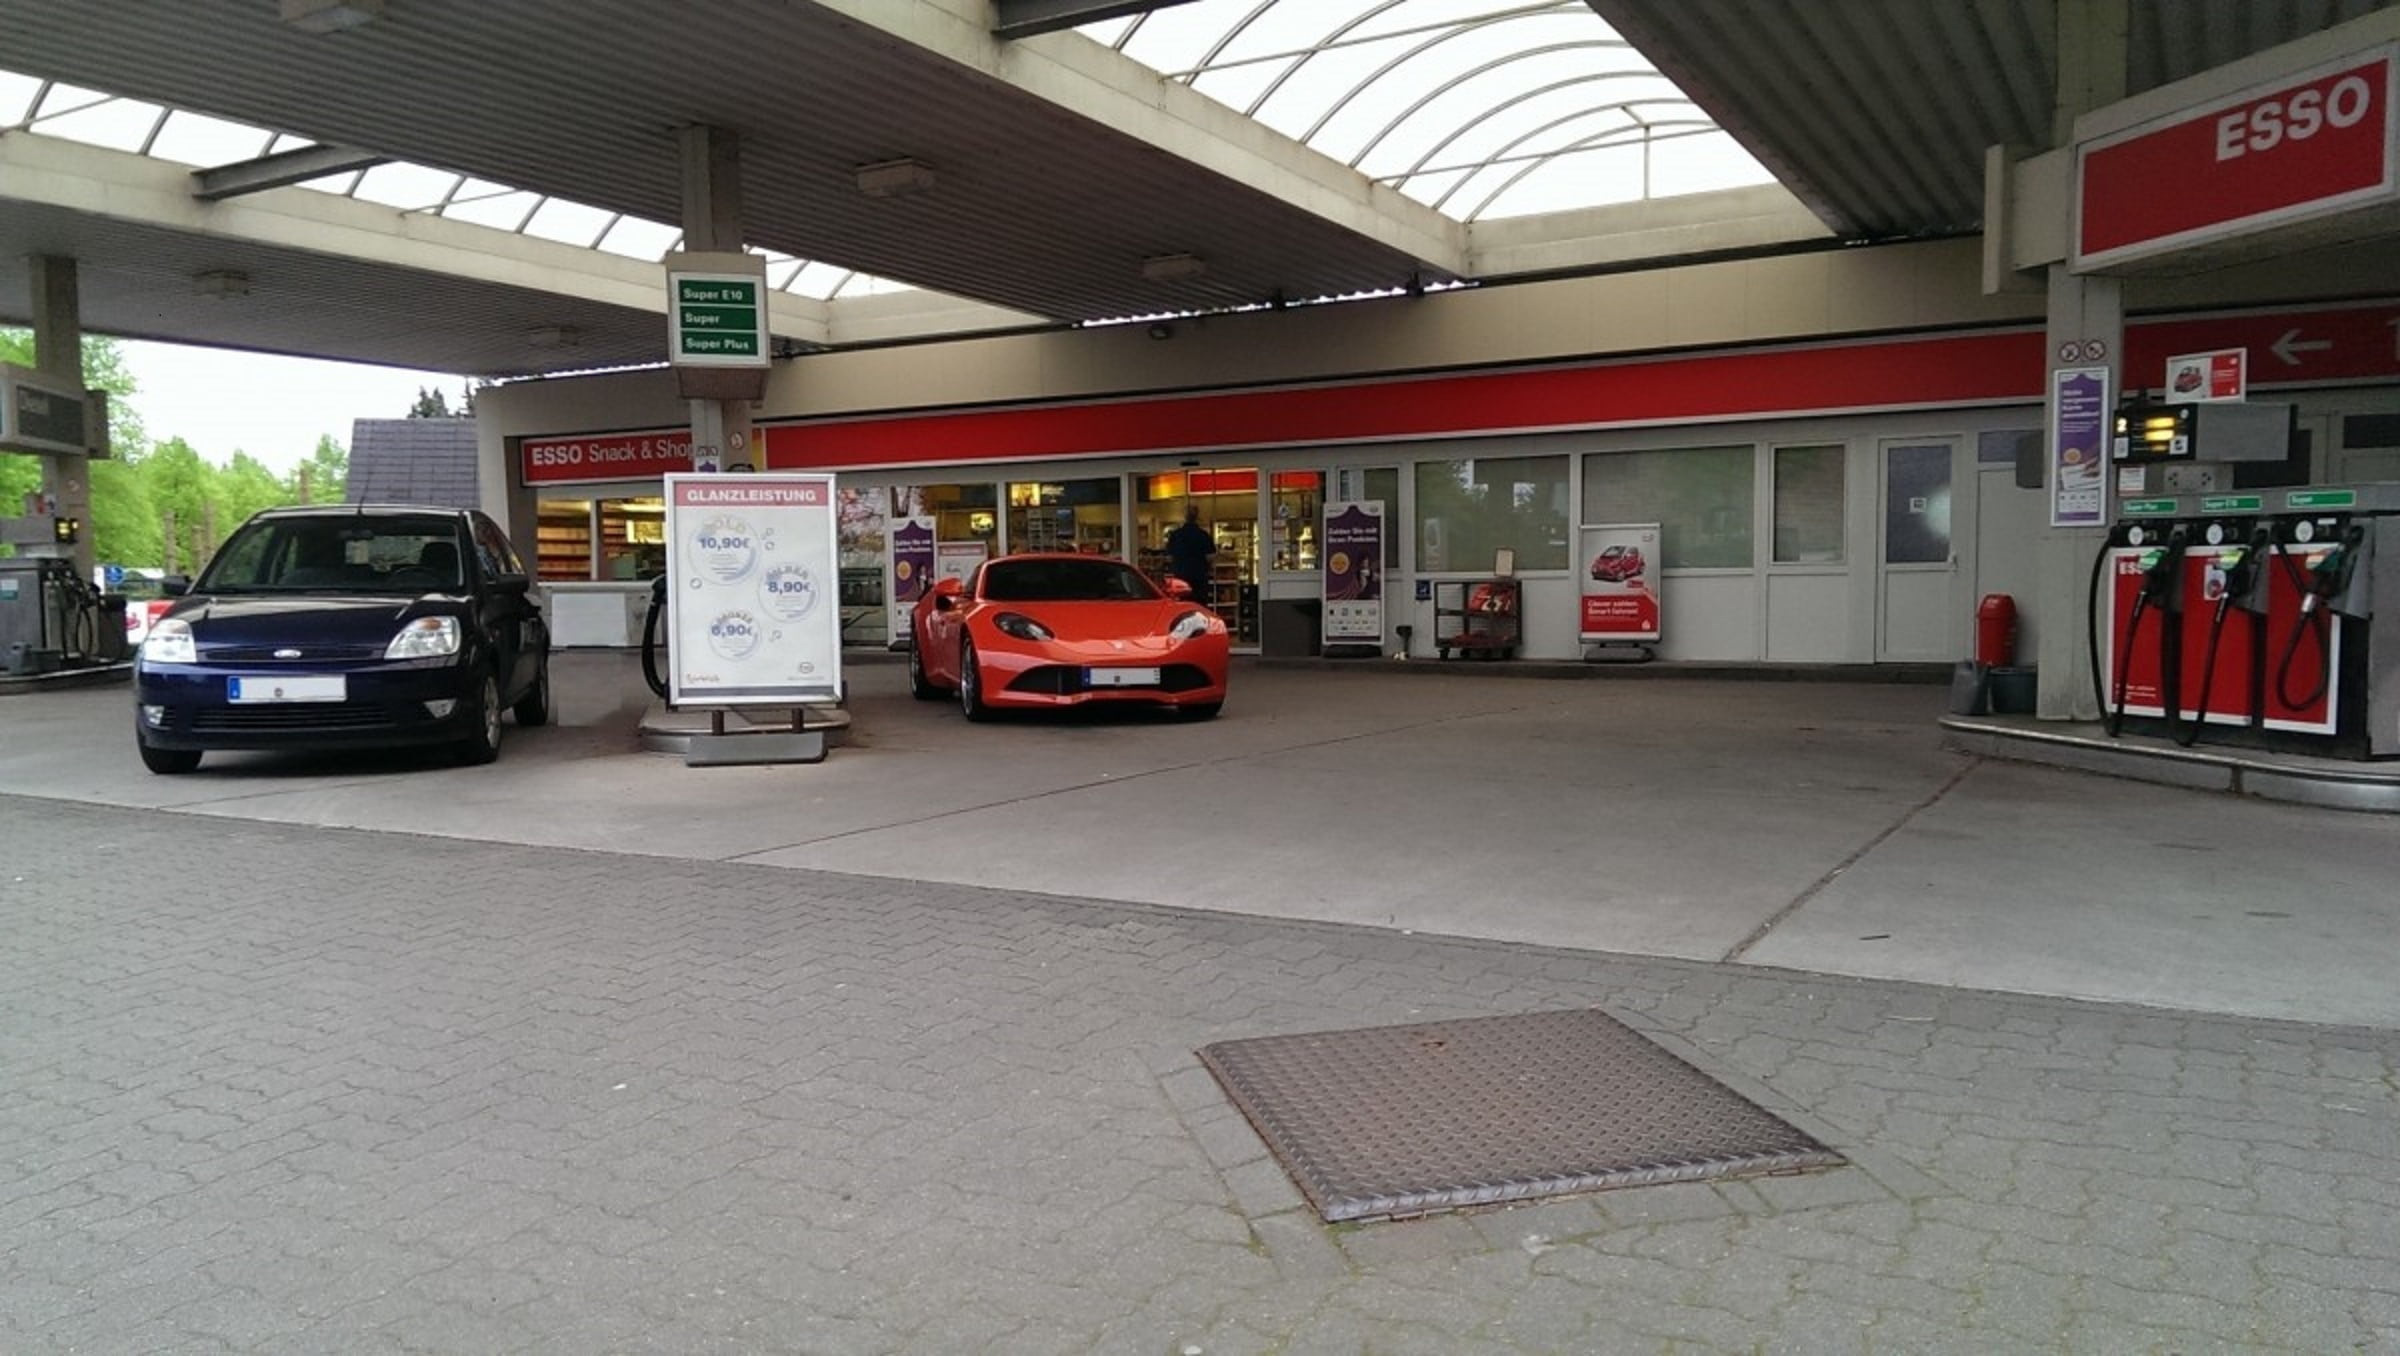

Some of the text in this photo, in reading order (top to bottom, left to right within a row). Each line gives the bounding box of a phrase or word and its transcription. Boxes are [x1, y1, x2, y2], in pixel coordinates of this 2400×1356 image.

[2216, 76, 2371, 164] ESSO
[683, 287, 743, 301] Super E10
[685, 312, 720, 325] Super
[685, 337, 749, 350] Super Plus
[532, 444, 583, 466] ESSO
[588, 442, 635, 463] Snack
[641, 440, 652, 459] &
[687, 489, 817, 502] GLANZLEISTUNG
[698, 536, 751, 551] 10,90€
[767, 581, 811, 596] 8,90€
